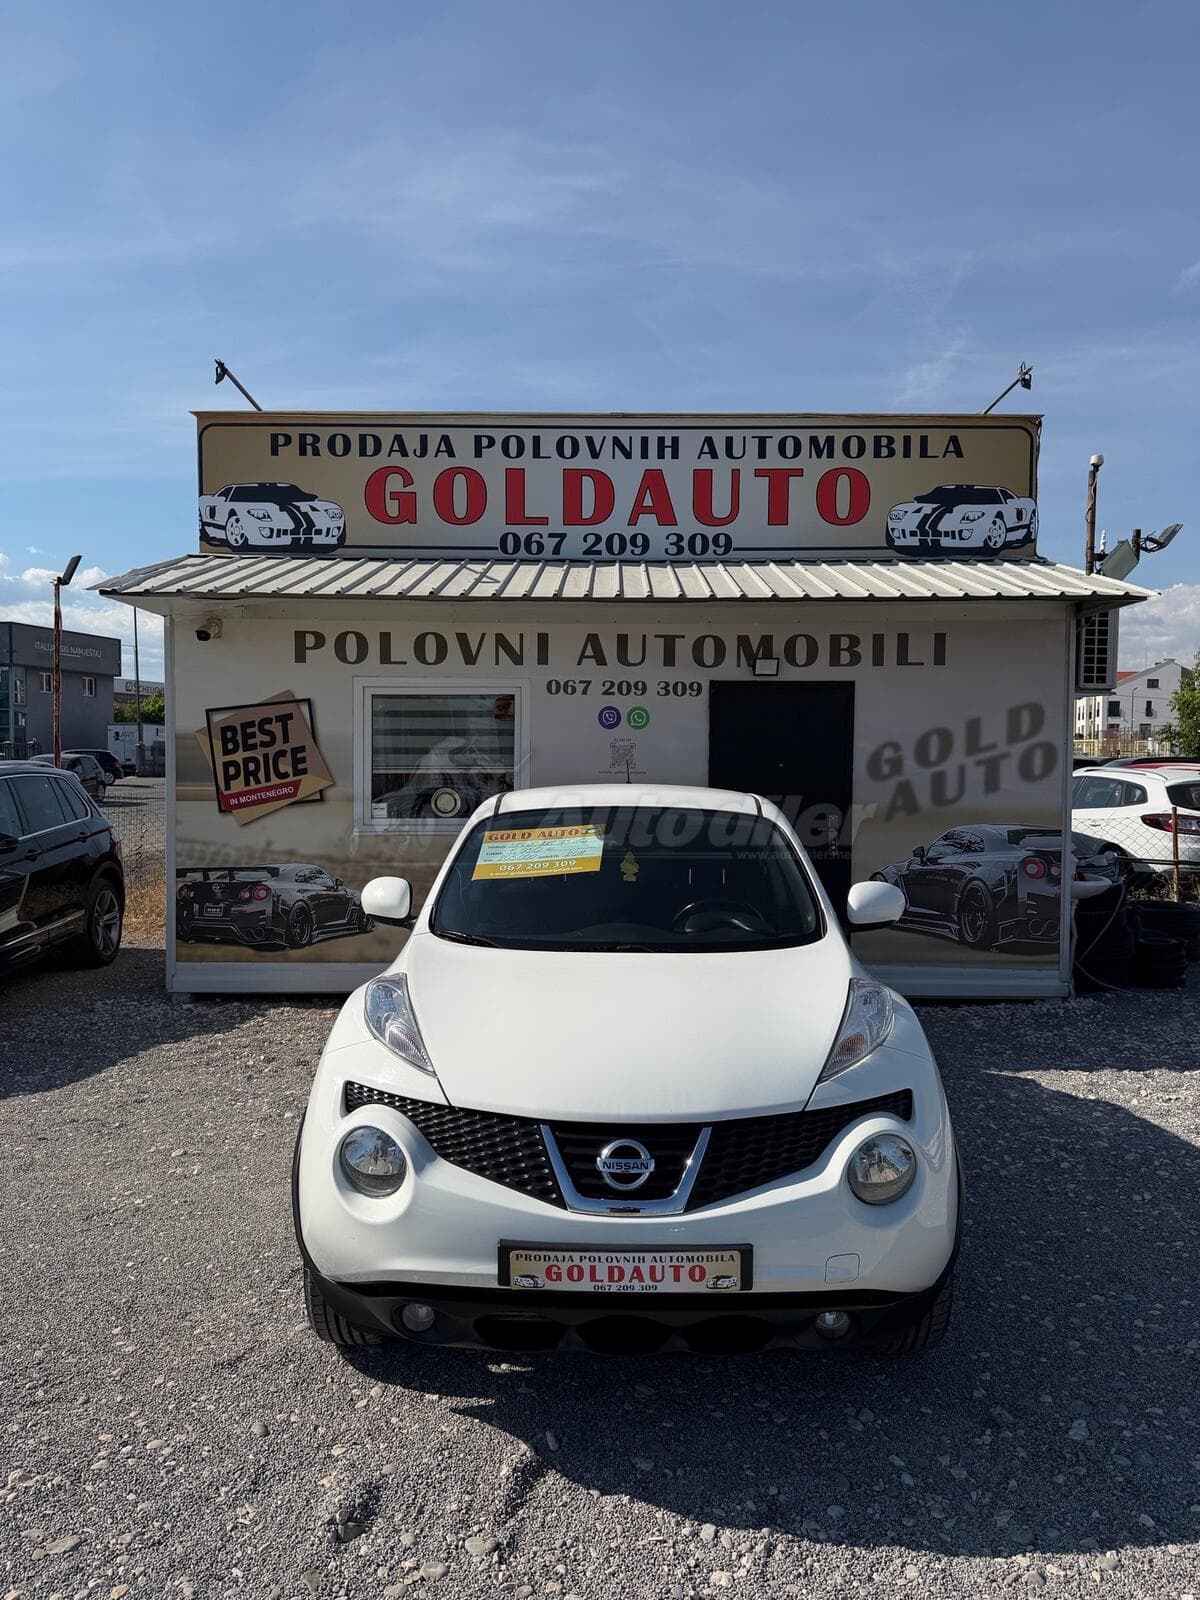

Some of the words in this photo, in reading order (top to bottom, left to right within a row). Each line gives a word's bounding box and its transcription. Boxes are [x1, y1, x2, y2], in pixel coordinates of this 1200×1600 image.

[269, 433, 456, 458] PRODAJA
[474, 434, 680, 460] POLOVNIH
[697, 434, 965, 460] AUTOMOBILA
[364, 465, 871, 527] GOLDAUTO
[499, 532, 568, 556] 067
[582, 532, 651, 557] 209
[664, 532, 733, 556] 309
[34, 641, 69, 654] ITALIJSKI
[294, 630, 550, 666] POLOVNI
[576, 632, 948, 668] AUTOMOBILI
[546, 679, 592, 696] 067
[601, 680, 648, 696] 209
[656, 680, 703, 697] 309
[220, 712, 294, 756] BEST
[866, 702, 1045, 781] GOLD
[222, 745, 309, 791] PRICE
[885, 741, 1058, 823] AUTO
[229, 798, 239, 806] IN
[239, 786, 295, 804] MONTENEGRO
[488, 832, 532, 840] GOLD
[537, 828, 580, 838] AUTO
[499, 863, 522, 872] 067
[526, 861, 550, 870] 209
[553, 859, 577, 868] 309
[602, 1160, 650, 1171] NISSAN
[515, 1253, 575, 1264] PRODAJA
[579, 1255, 647, 1264] POLOVNIH
[650, 1254, 736, 1264] AUTOMOBILA
[544, 1264, 707, 1283] GOLDAUTO
[593, 1284, 613, 1292] 067
[615, 1284, 636, 1292] 209
[638, 1284, 658, 1292] 309
